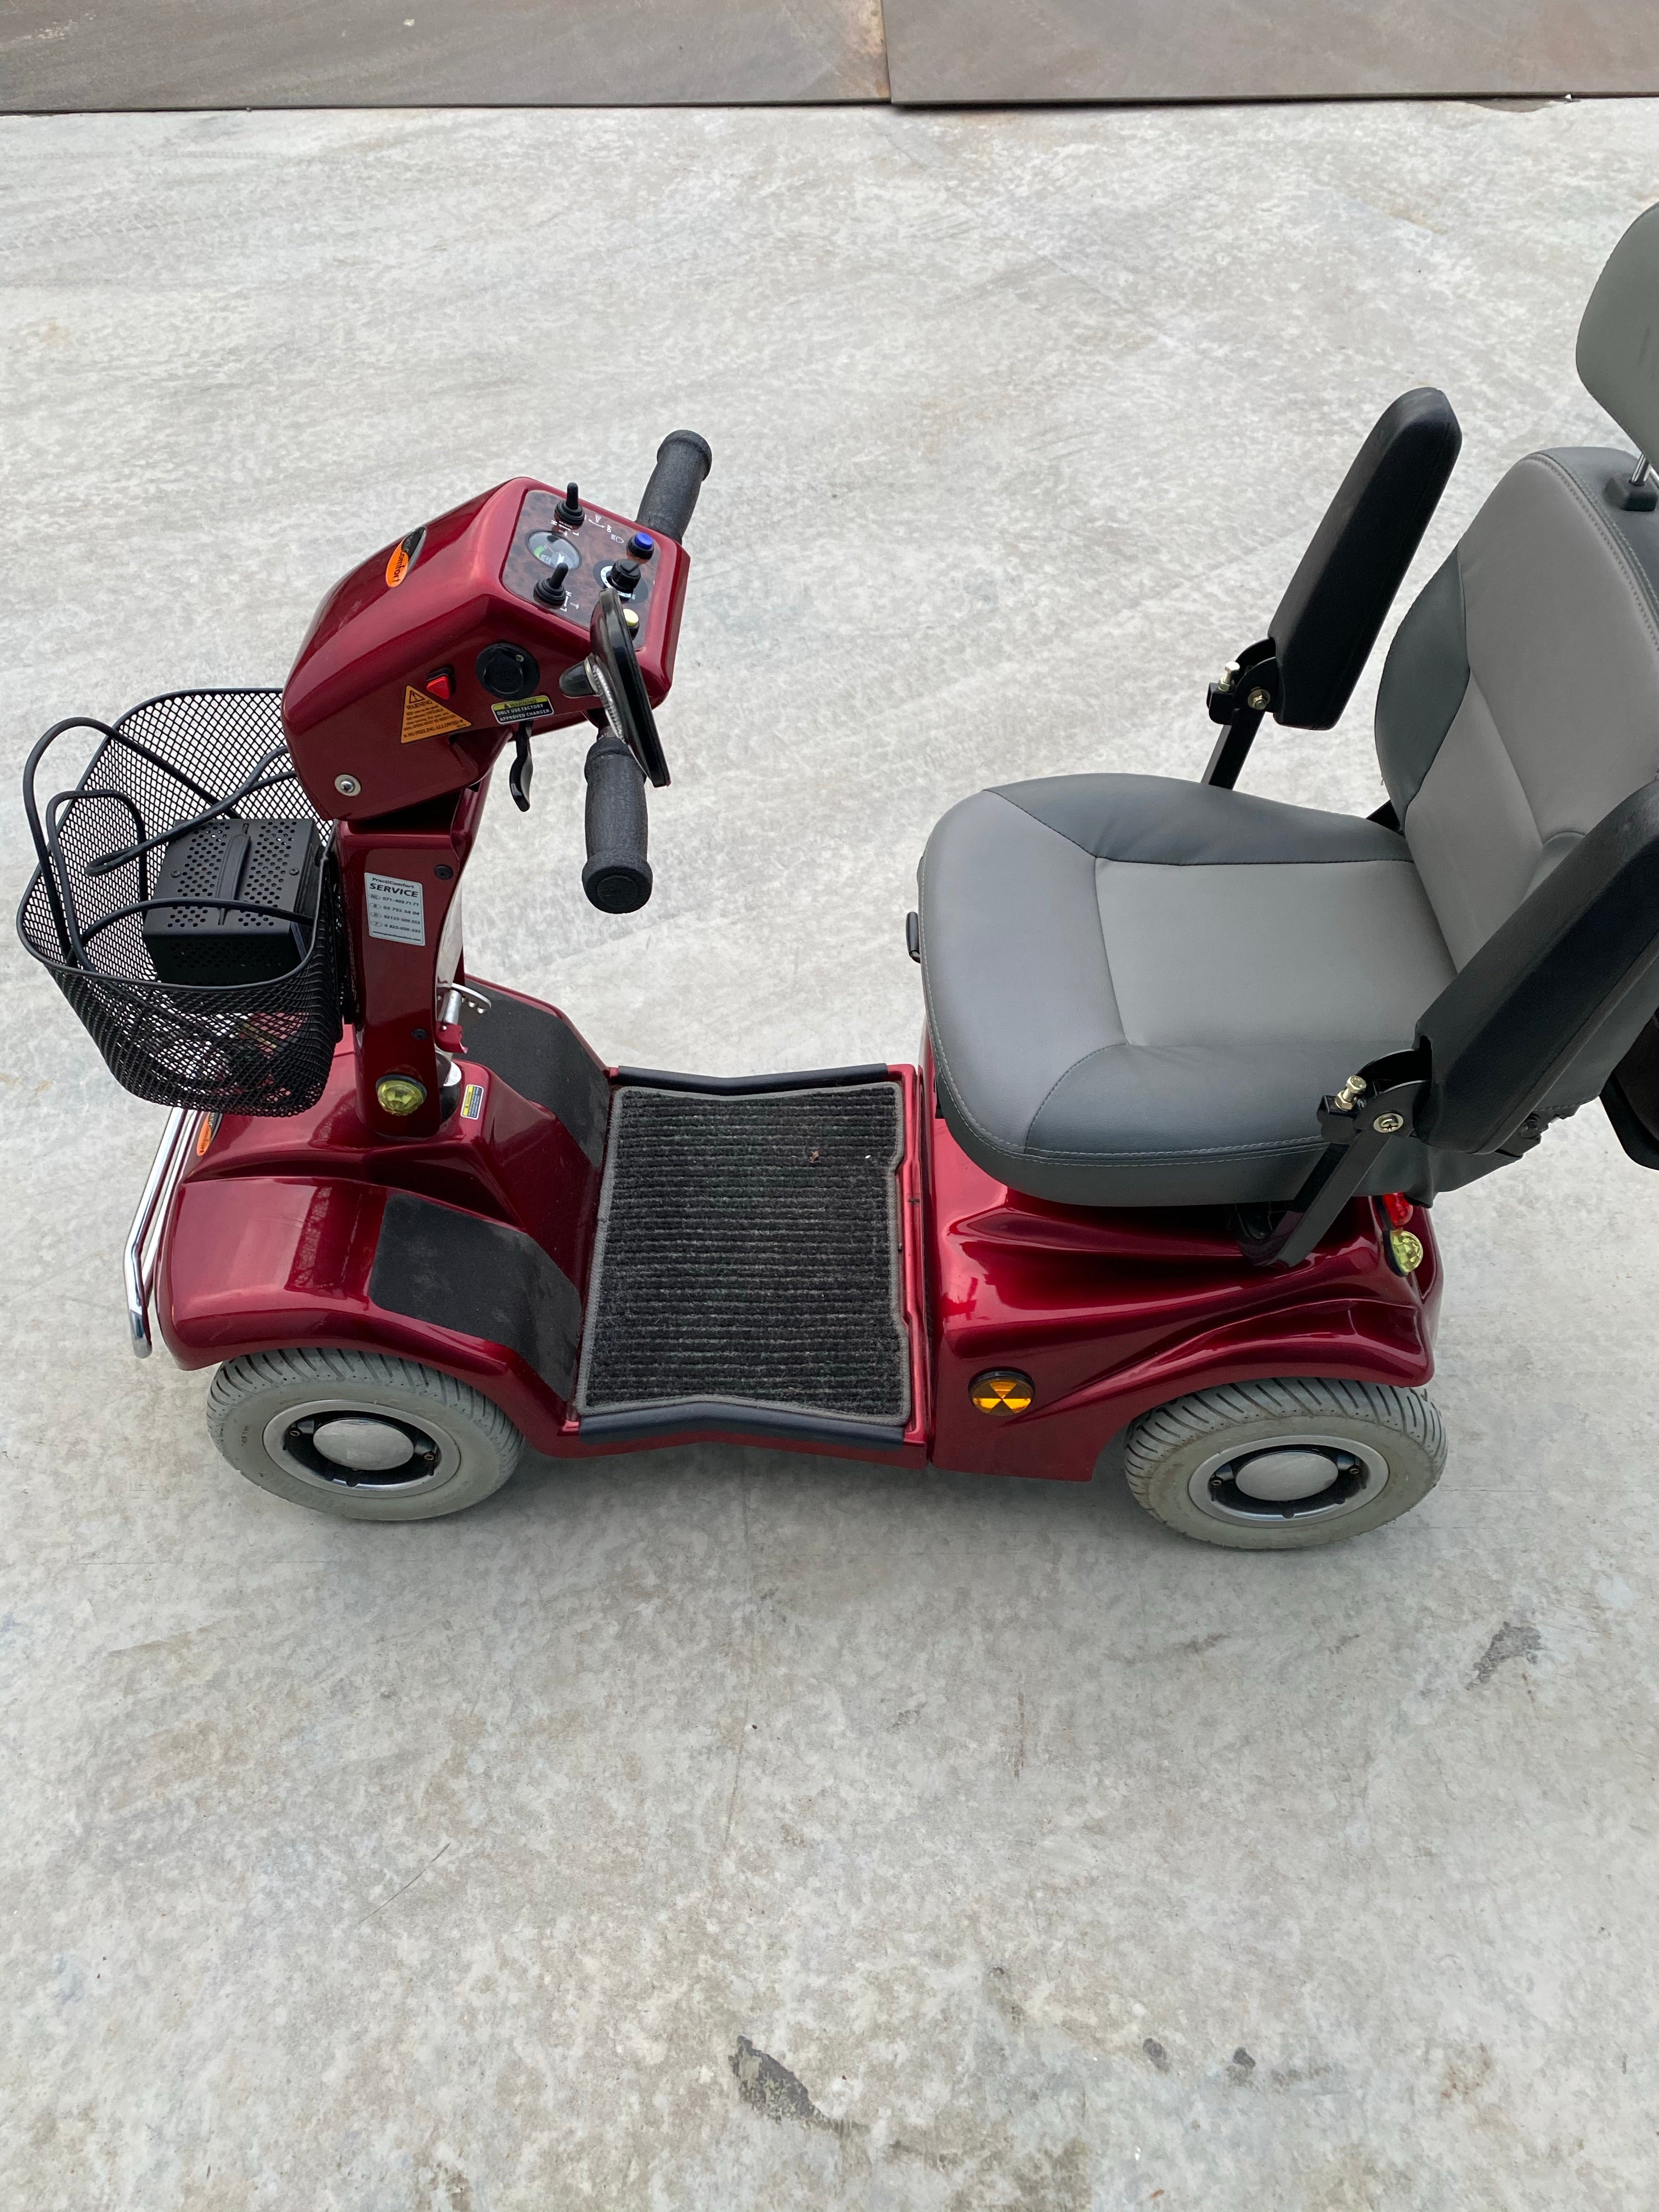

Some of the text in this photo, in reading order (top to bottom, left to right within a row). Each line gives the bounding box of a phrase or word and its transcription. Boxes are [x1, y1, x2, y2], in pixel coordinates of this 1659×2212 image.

[406, 699, 432, 710] WARNING
[510, 699, 537, 708] WARNING
[436, 721, 460, 729] ALLOWED
[372, 878, 414, 888] PractiComfort
[369, 883, 419, 898] SERVICE
